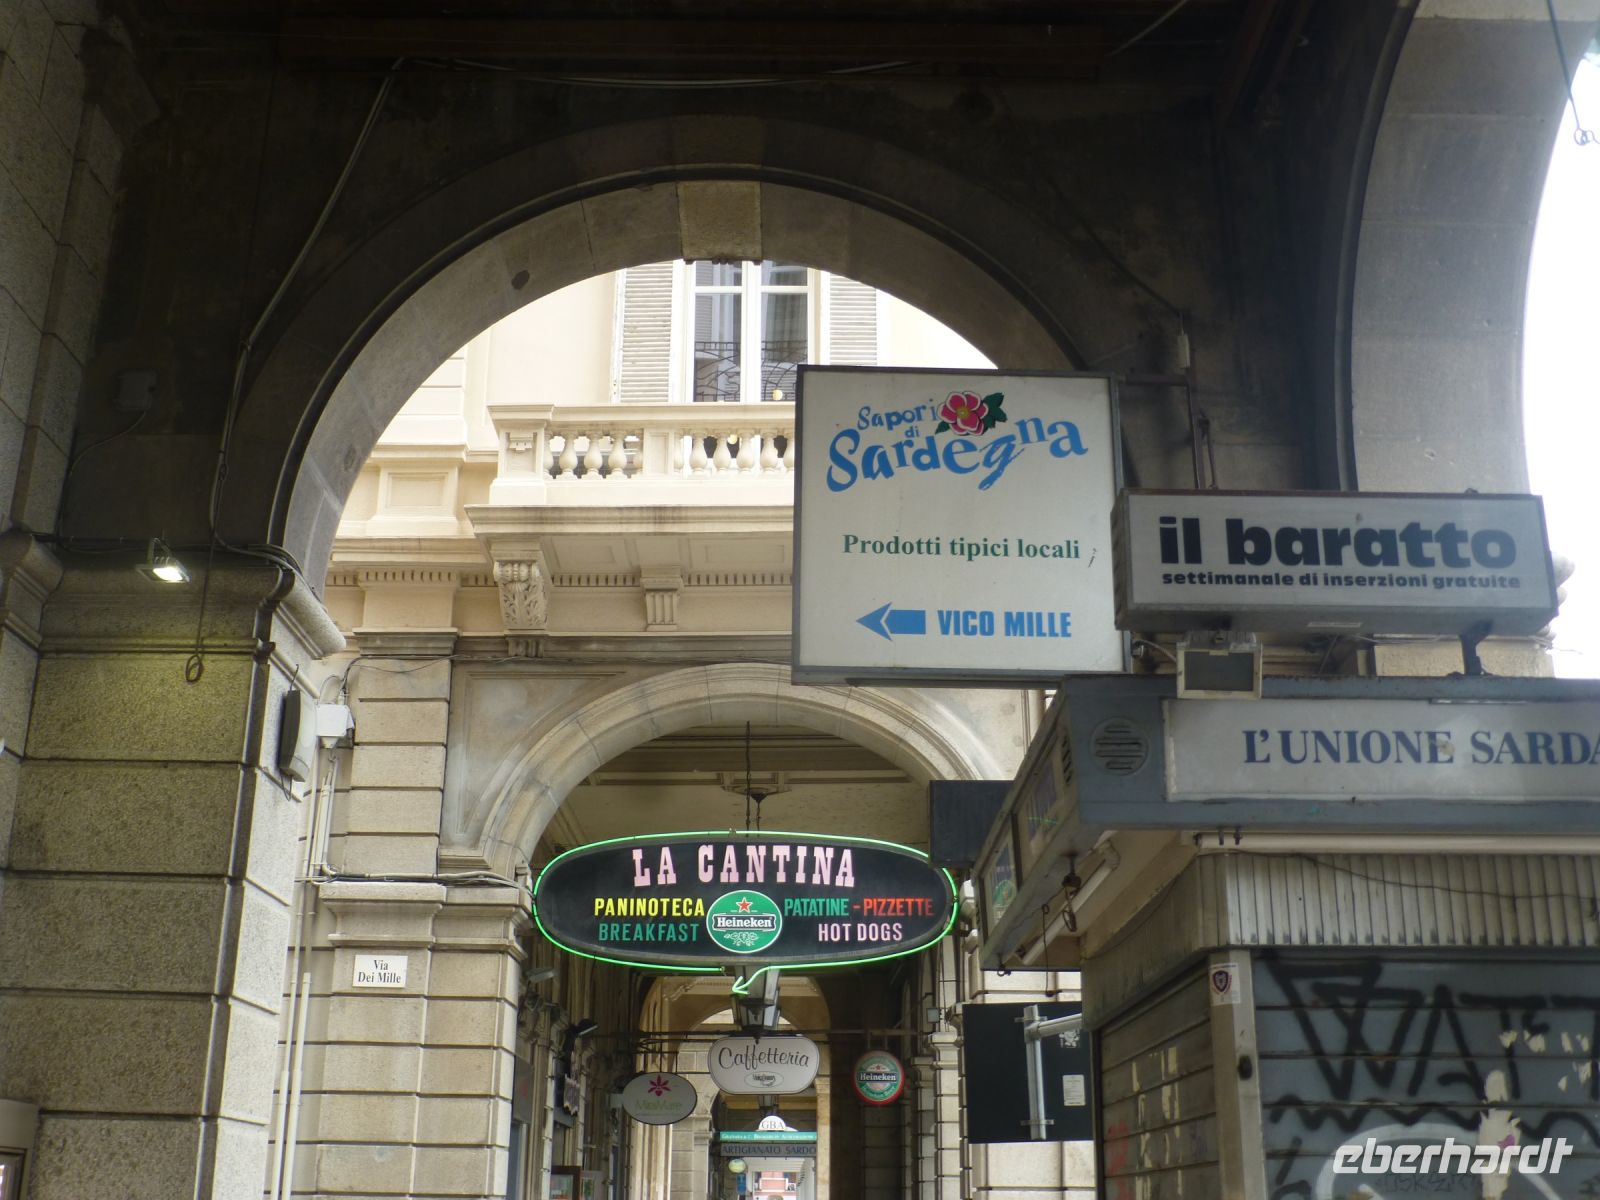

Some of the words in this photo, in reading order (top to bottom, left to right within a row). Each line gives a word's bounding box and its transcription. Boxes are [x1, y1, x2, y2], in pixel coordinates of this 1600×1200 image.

[857, 398, 938, 432] Sapori
[904, 425, 920, 438] di
[826, 416, 1089, 493] Sardegna
[842, 533, 942, 556] Prodotti
[949, 537, 1010, 562] tipici
[1017, 538, 1081, 559] locali
[1159, 516, 1202, 565] il
[1225, 517, 1517, 570] baratto
[1162, 570, 1294, 587] settimanale
[1299, 572, 1319, 587] di
[1323, 572, 1428, 589] inserzioni
[1432, 574, 1521, 591] gratuite
[937, 609, 995, 637] VICO
[1004, 611, 1072, 638] MILLE
[631, 845, 678, 888] LA
[698, 844, 855, 888] CANTINA
[593, 897, 705, 918] PANINOTECA
[783, 897, 850, 918] PATATINE
[863, 898, 935, 918] PIZZETTE
[598, 922, 700, 942] BREAKFAST
[716, 916, 773, 928] Heineken
[818, 923, 851, 942] HOT
[857, 923, 903, 942] DOGS
[373, 959, 389, 971] Via
[358, 971, 375, 983] Dei
[378, 972, 402, 984] Mille
[718, 1044, 809, 1071] Caffetteria
[860, 1073, 897, 1081] Heineken
